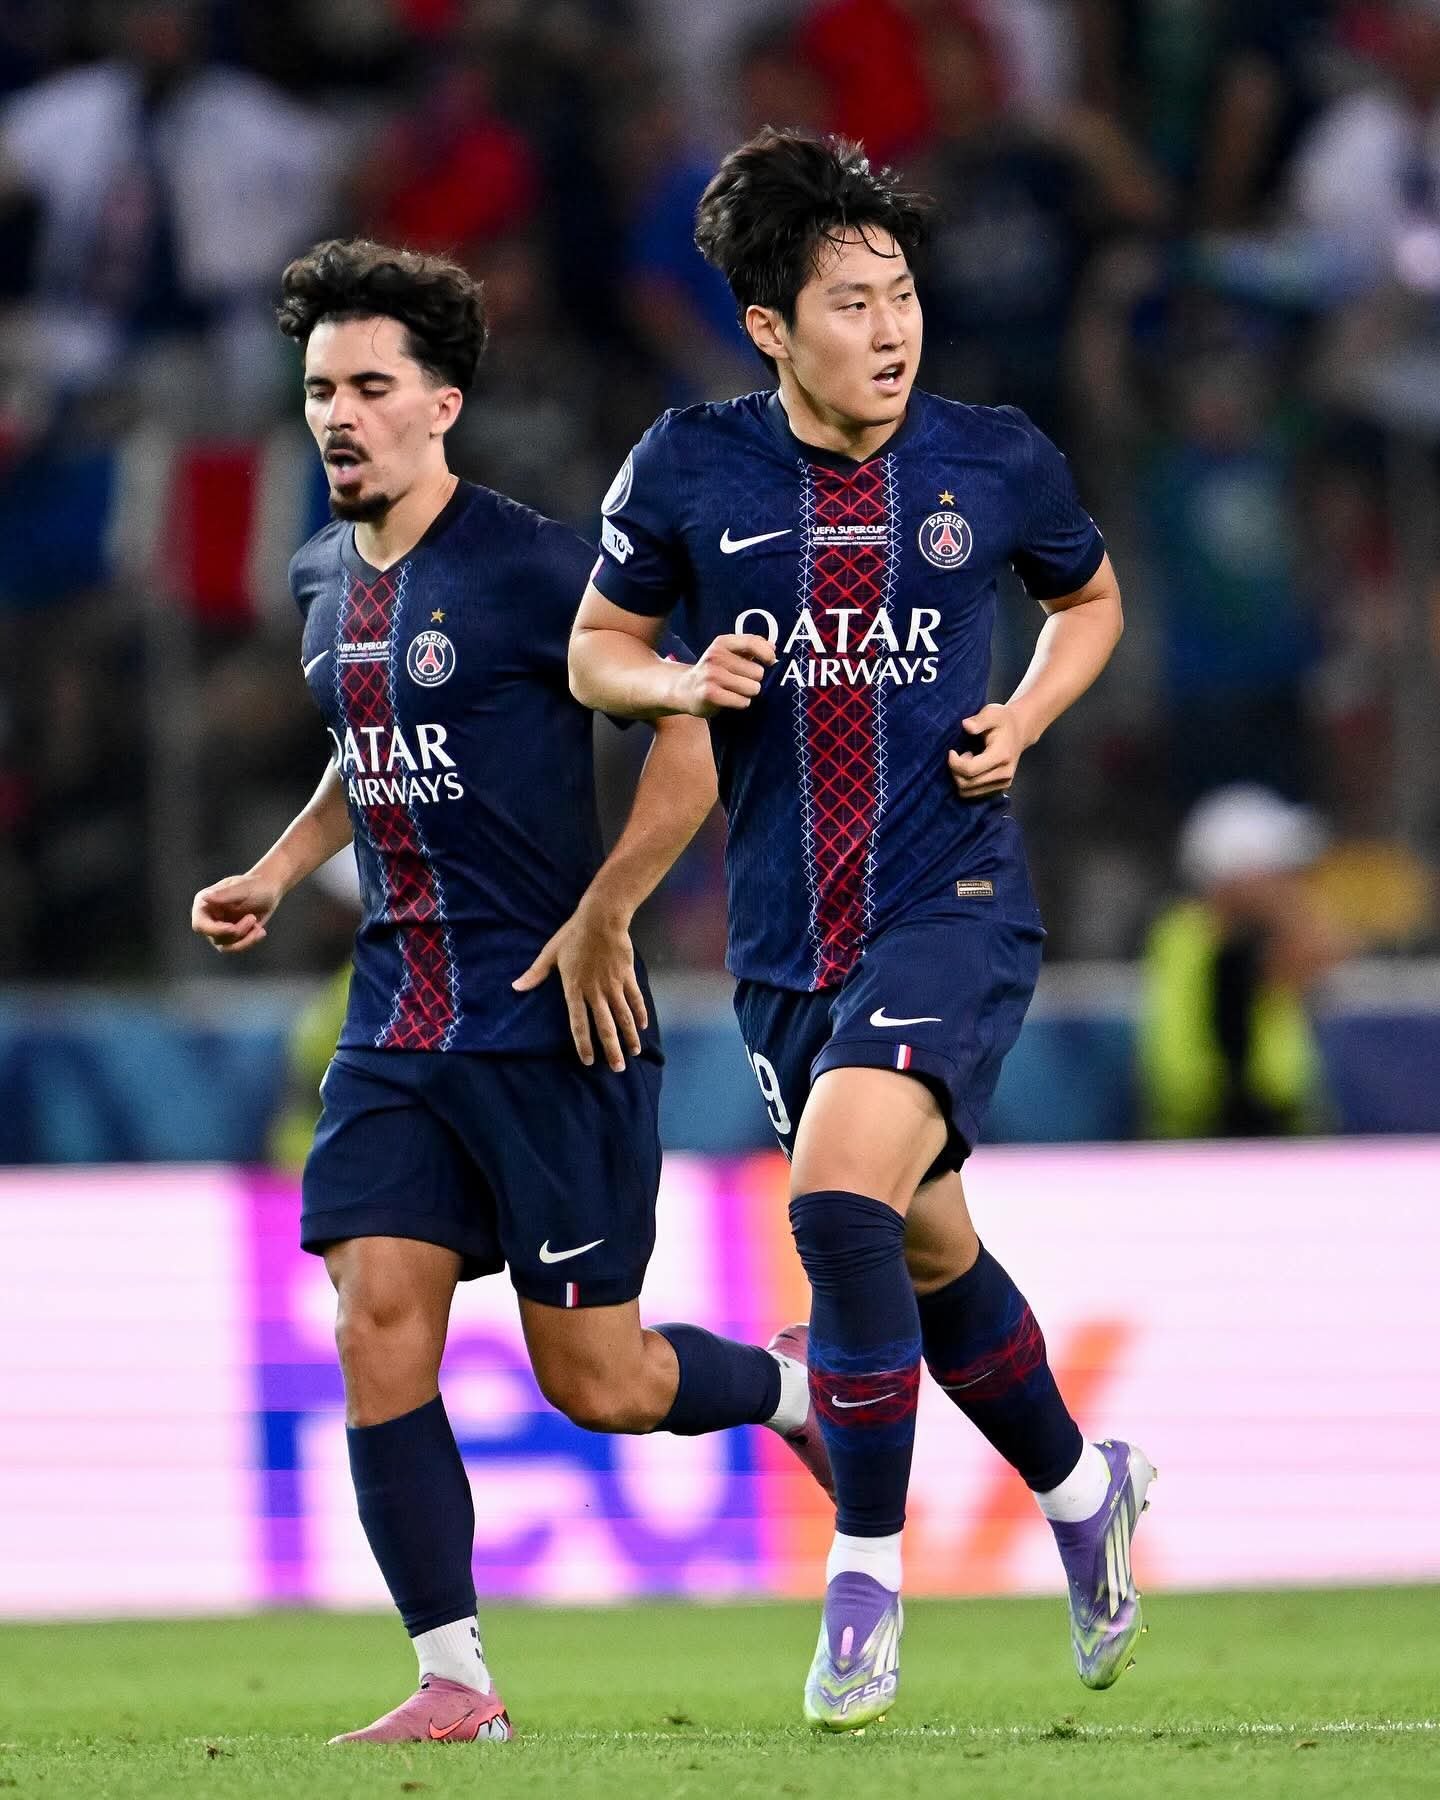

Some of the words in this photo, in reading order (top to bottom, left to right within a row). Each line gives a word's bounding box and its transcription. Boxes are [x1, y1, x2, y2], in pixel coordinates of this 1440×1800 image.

[812, 526, 837, 535] UEFA
[837, 525, 866, 534] SUPER
[866, 525, 887, 534] CUP
[928, 514, 964, 529] PARIS
[416, 633, 448, 649] PARIS
[779, 656, 940, 687] AIRWAYS
[348, 772, 464, 806] AIRWAYS
[744, 1044, 792, 1135] 9
